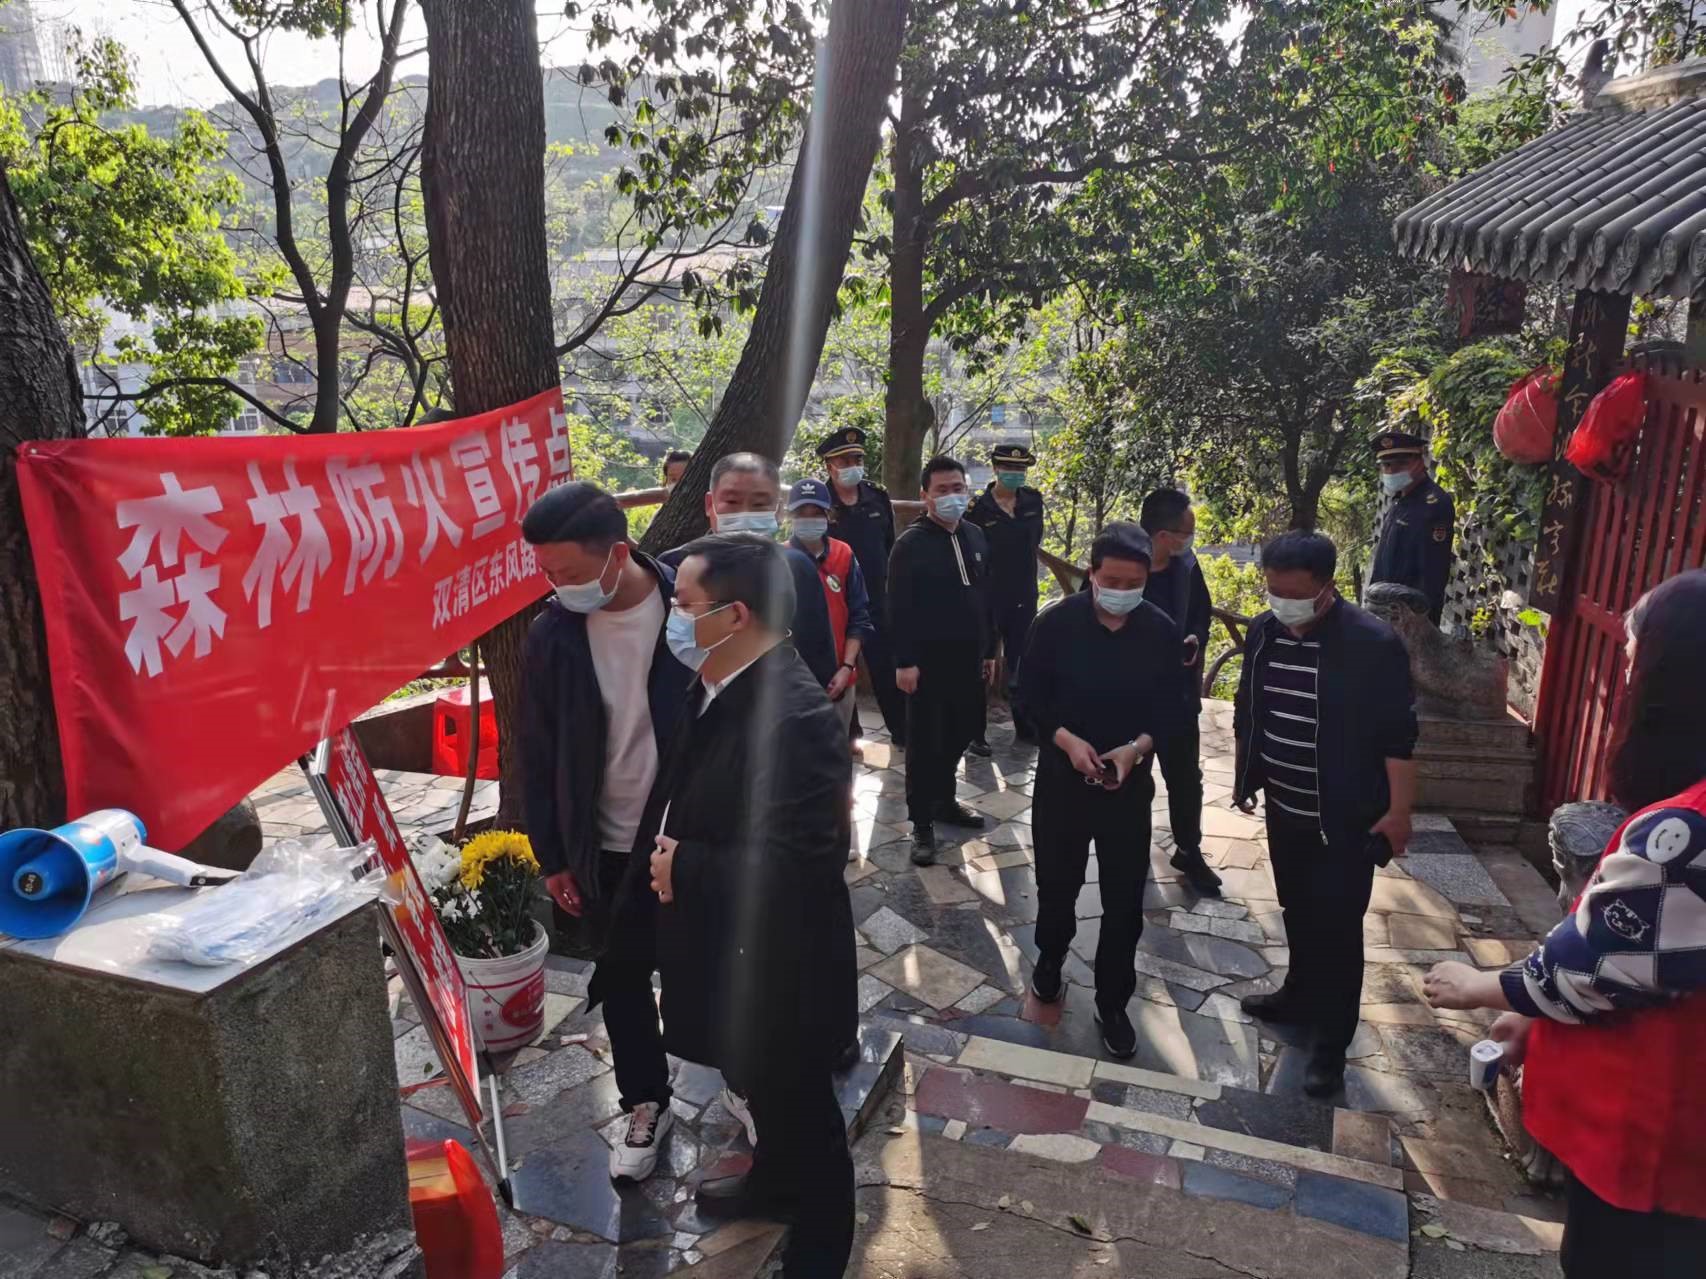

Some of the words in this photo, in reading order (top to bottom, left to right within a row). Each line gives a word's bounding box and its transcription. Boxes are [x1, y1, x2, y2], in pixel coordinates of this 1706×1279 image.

[116, 407, 572, 678] 森林防火宣传点
[432, 537, 542, 630] 双清区东风路
